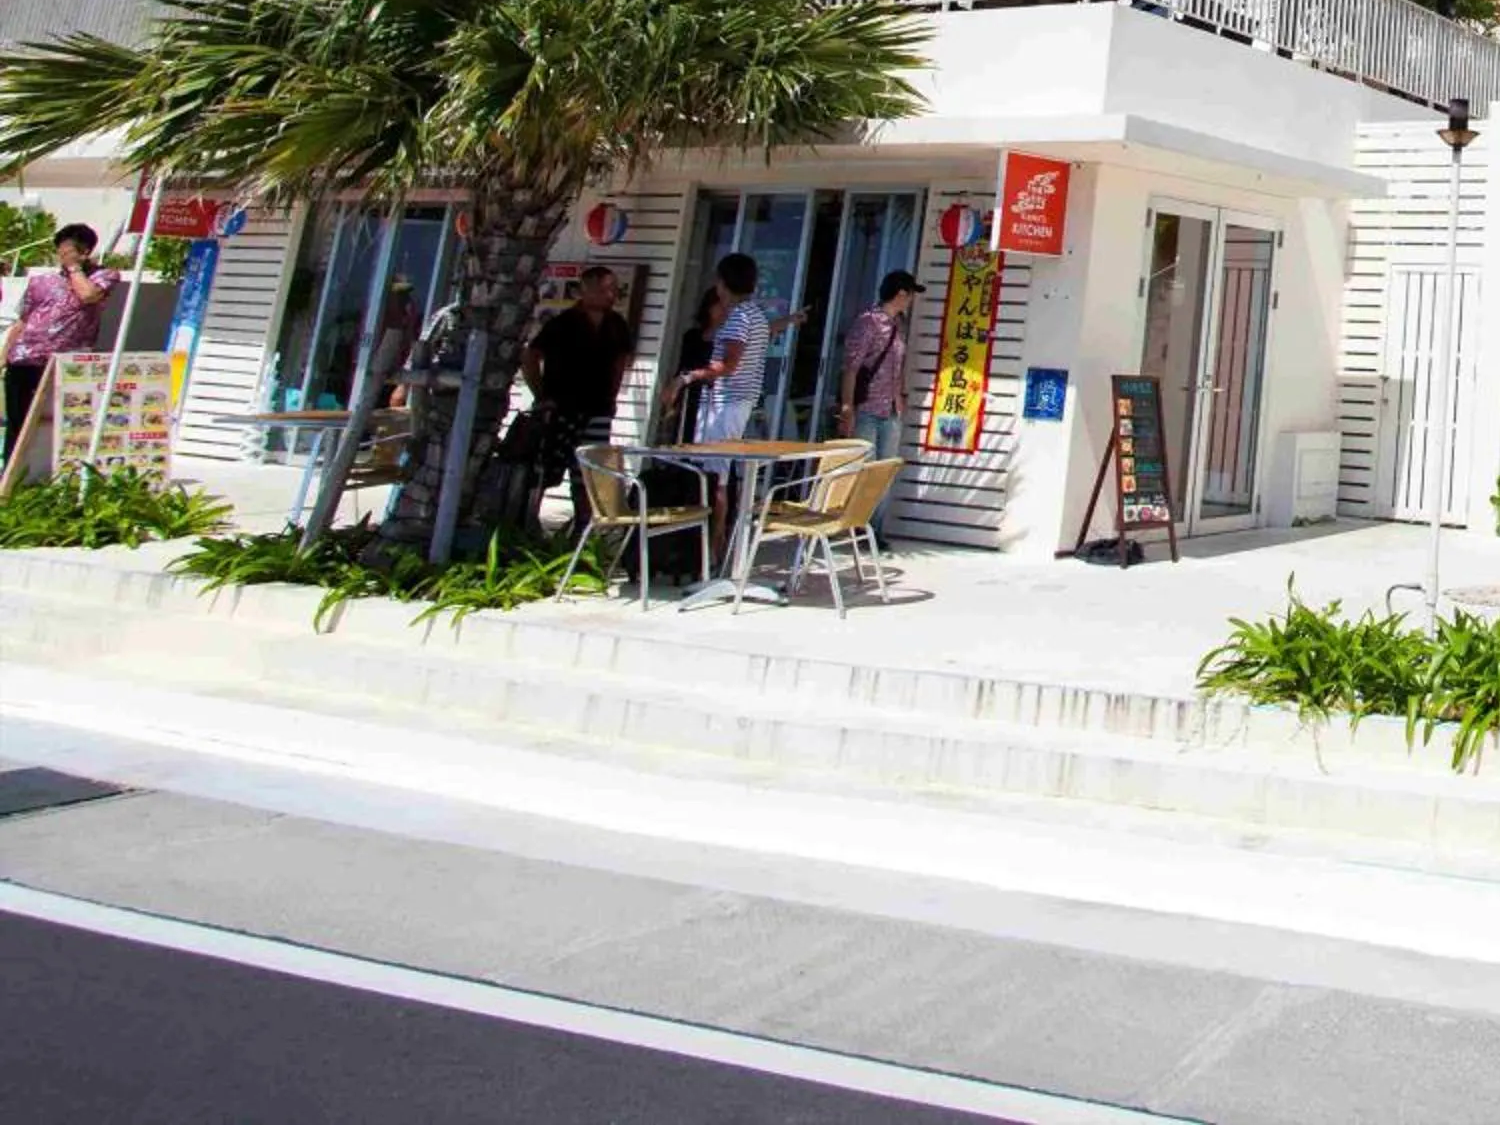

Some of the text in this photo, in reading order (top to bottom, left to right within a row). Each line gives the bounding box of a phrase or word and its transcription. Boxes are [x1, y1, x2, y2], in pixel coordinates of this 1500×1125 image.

[1011, 222, 1054, 239] KITCHEN
[943, 274, 982, 414] やんばる島豚
